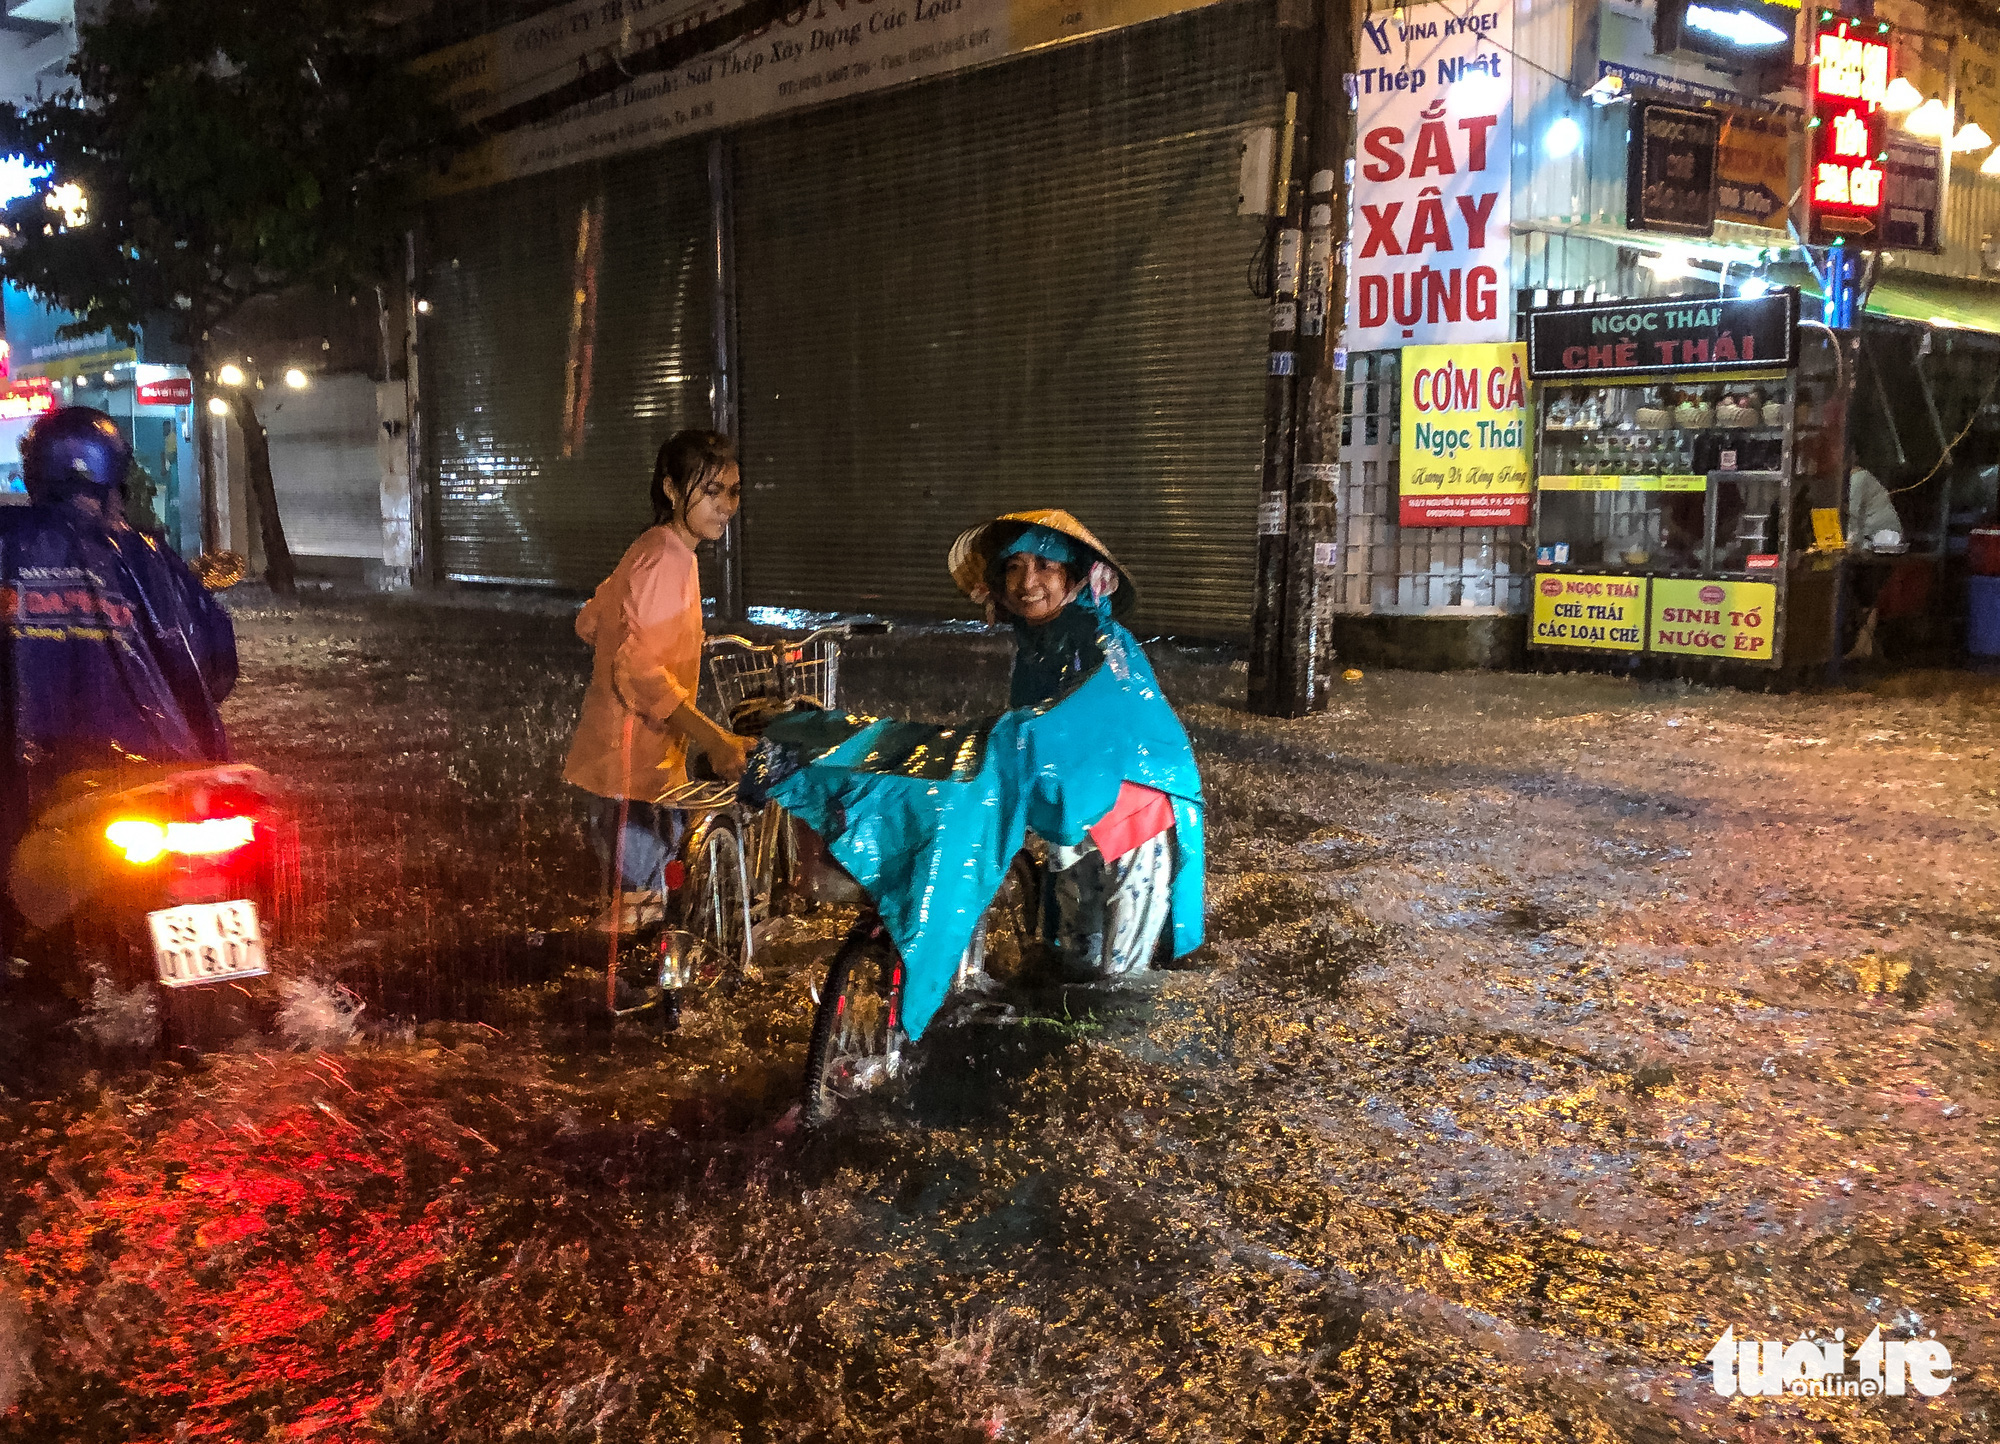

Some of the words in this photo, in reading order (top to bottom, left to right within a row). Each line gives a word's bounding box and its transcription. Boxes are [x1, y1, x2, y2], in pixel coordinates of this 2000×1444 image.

[809, 22, 863, 52] Dựng
[868, 7, 907, 34] Các
[1399, 22, 1437, 42] VINA
[1444, 12, 1498, 36] KYOEI
[1360, 66, 1426, 94] Thép
[1362, 97, 1498, 183] SẮT
[1358, 185, 1499, 259] XÂY
[1358, 264, 1498, 339] DỰNG
[1591, 313, 1659, 336] NGỌC
[1561, 336, 1640, 370] CHÈ
[1653, 330, 1756, 365] THÁI
[1413, 359, 1479, 412] CƠM
[1487, 352, 1526, 412] GÀ
[1415, 422, 1471, 459] Ngọc
[1476, 419, 1524, 449] Thái
[1566, 581, 1604, 599] NGỌC
[1606, 581, 1640, 598] THÁI
[1554, 601, 1583, 618] CHÈ
[1585, 602, 1624, 621] THÁI
[1662, 607, 1721, 626] SINH
[1727, 605, 1763, 628] TỐ
[1537, 621, 1568, 638] CÁC
[1570, 625, 1606, 644] LOẠI
[1609, 624, 1641, 643] CHÈ
[1657, 629, 1728, 650] NƯỚC
[1732, 631, 1766, 652] ÉP
